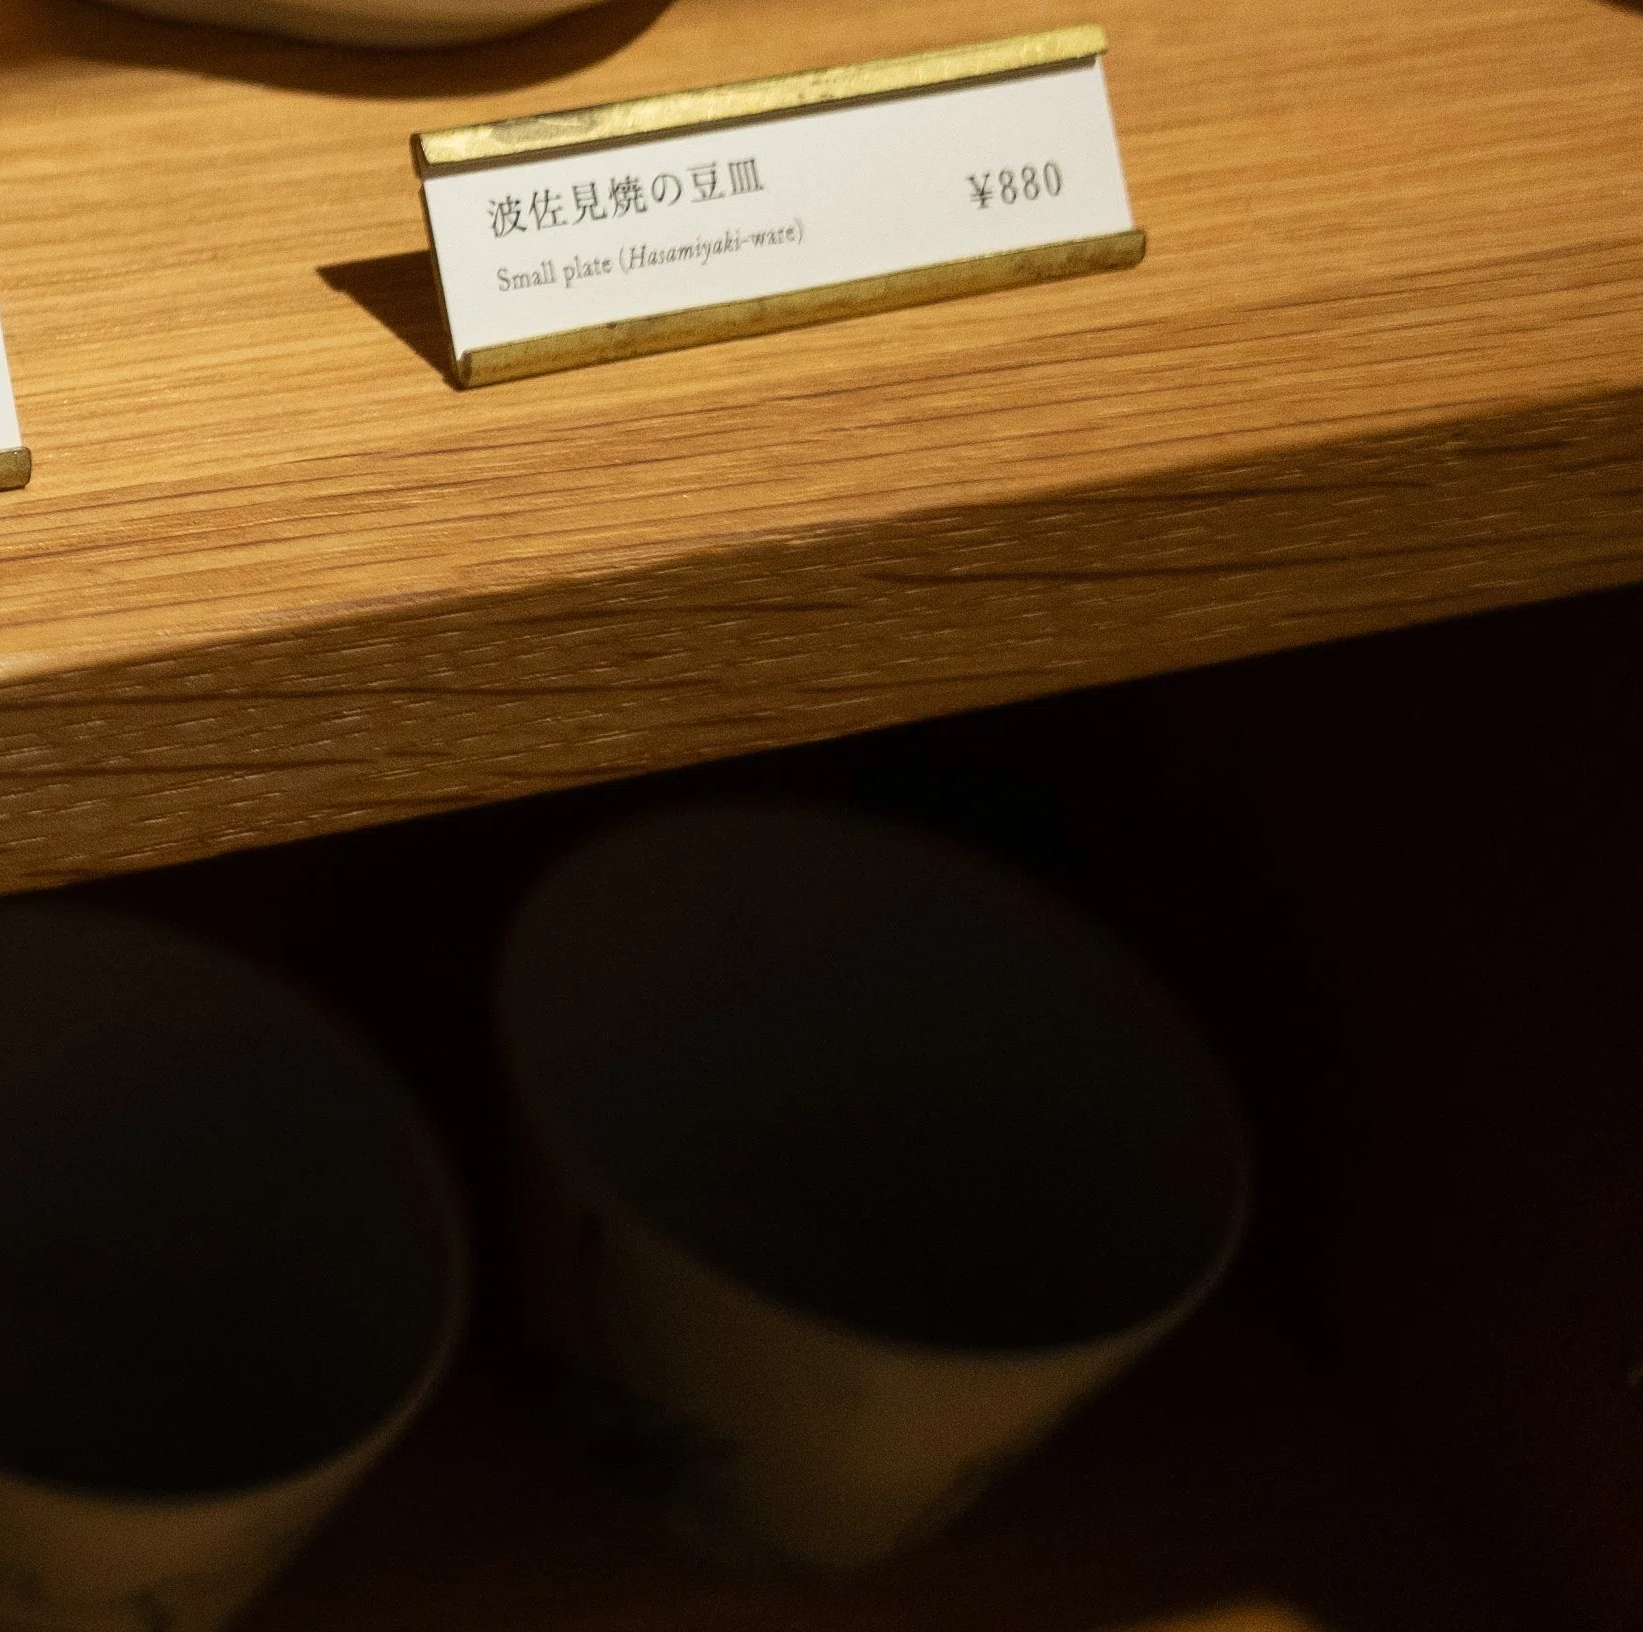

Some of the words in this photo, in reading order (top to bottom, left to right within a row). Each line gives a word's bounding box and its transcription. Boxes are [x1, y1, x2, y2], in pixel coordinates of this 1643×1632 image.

[487, 157, 765, 238] 波佐見焼の豆皿
[966, 160, 1064, 210] ¥880
[496, 259, 557, 292] Small
[562, 255, 613, 289] plate
[618, 219, 804, 272] (Hasamiyaki-ware)
